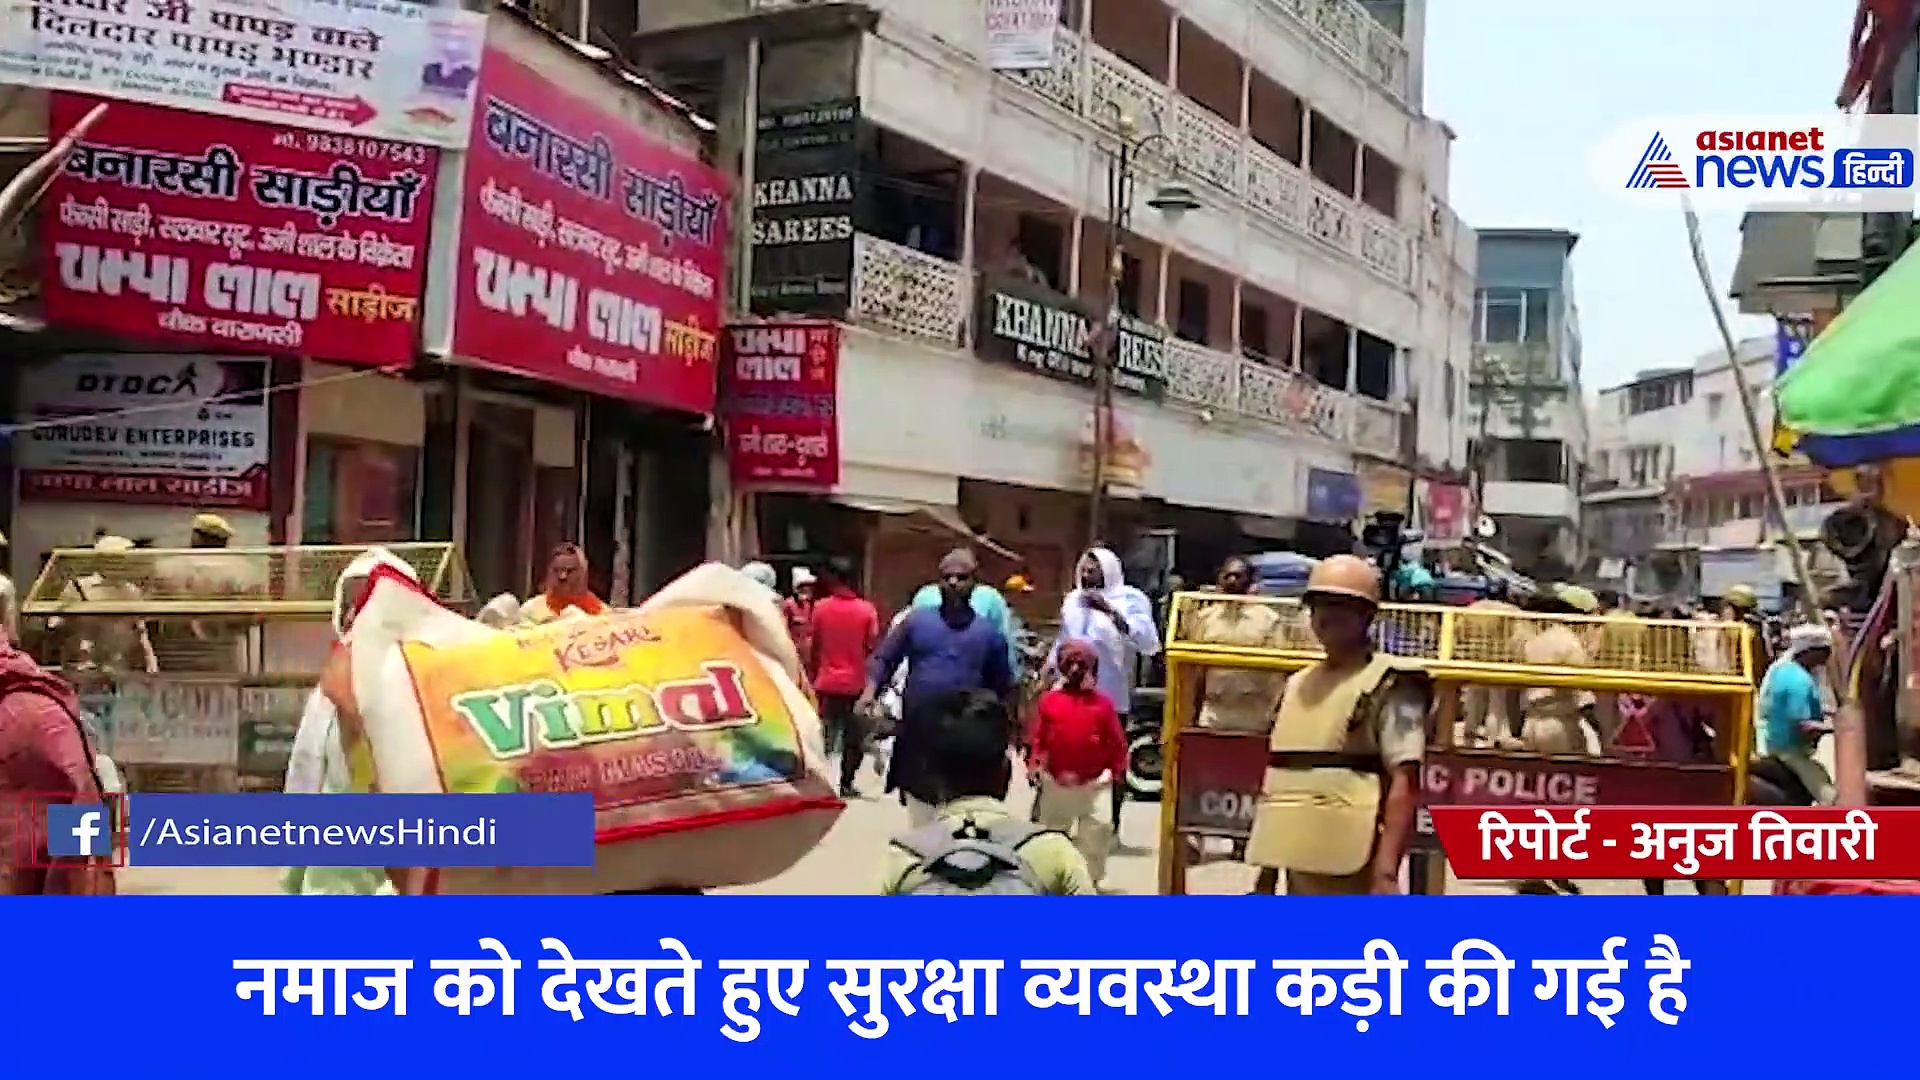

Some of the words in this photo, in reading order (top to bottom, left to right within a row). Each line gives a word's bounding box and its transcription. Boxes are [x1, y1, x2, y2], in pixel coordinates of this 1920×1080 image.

[65, 142, 242, 200] बनारसी
[485, 97, 616, 202] बनारसी
[754, 174, 855, 207] KHANNA
[55, 242, 190, 305] चम्पा
[203, 261, 321, 321] लाल
[472, 247, 579, 332] चम्पा
[588, 287, 661, 356] लाल
[994, 291, 1093, 359] KHANNA
[77, 373, 172, 394] DTDC
[126, 428, 256, 448] ENTERPRISES
[452, 661, 760, 760] Vimal
[1464, 767, 1599, 804] POLICE
